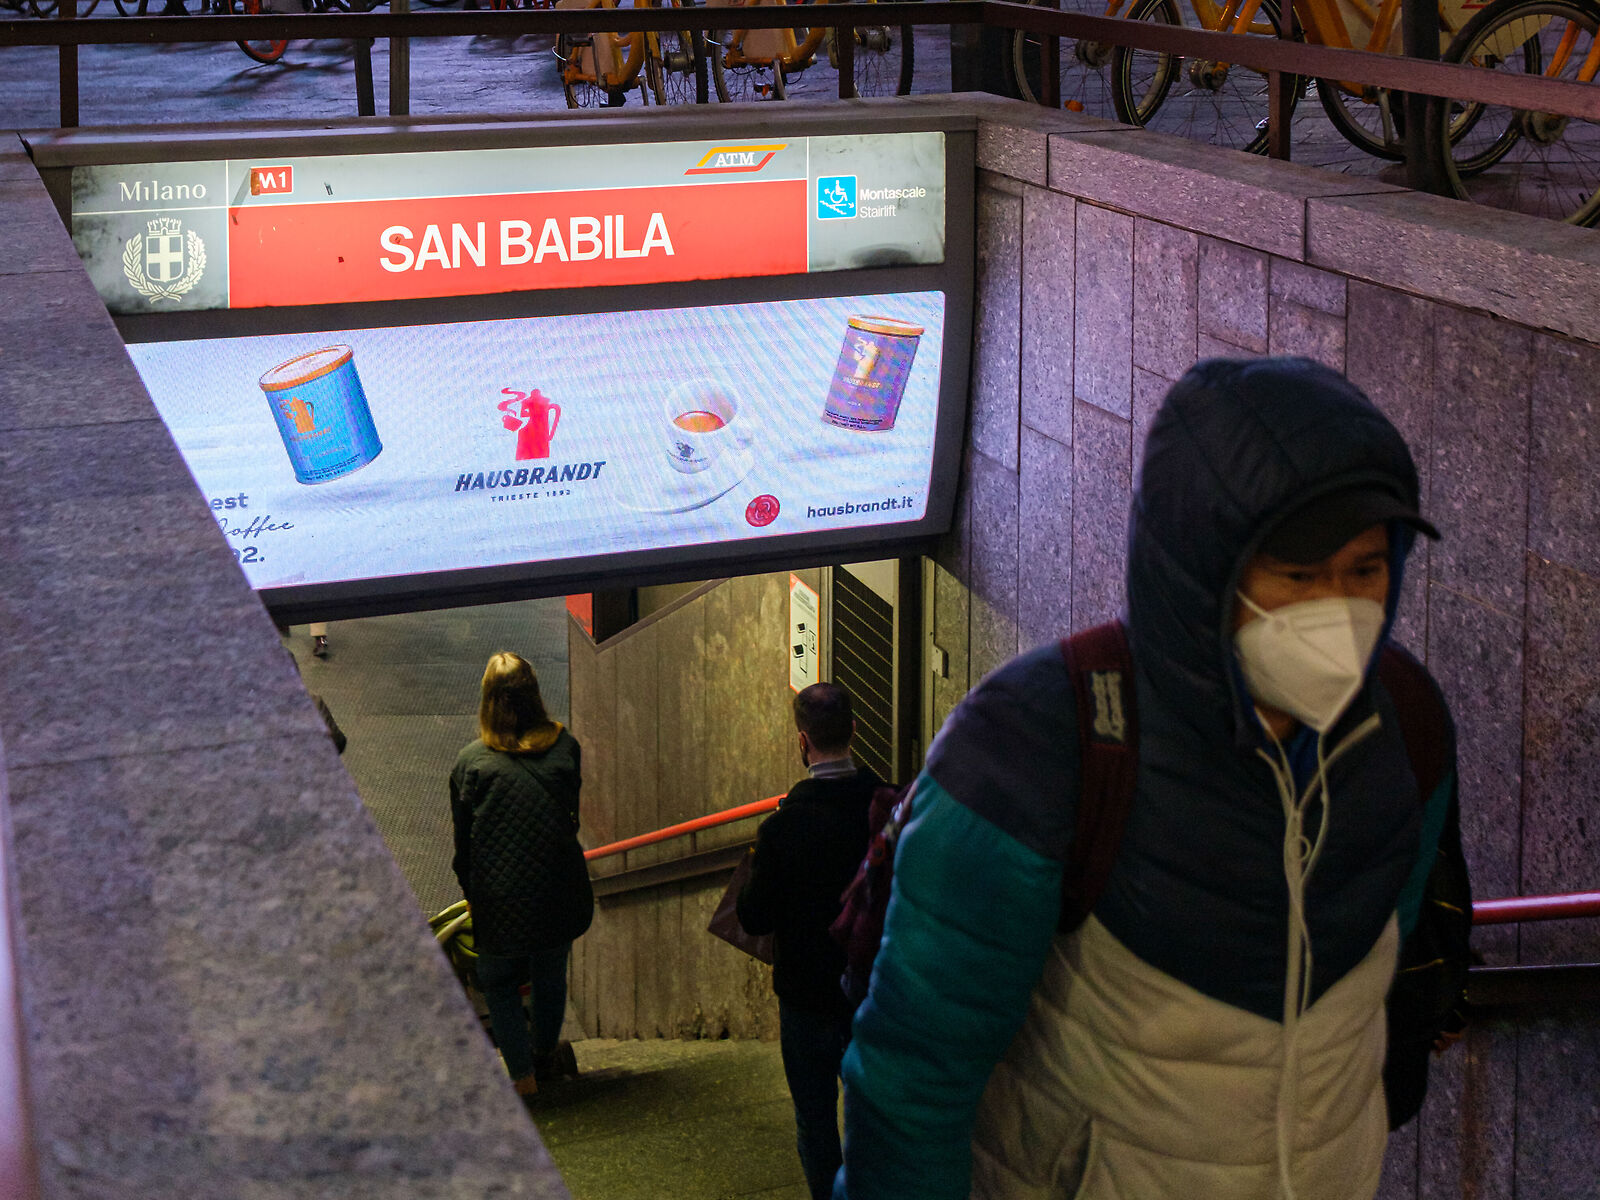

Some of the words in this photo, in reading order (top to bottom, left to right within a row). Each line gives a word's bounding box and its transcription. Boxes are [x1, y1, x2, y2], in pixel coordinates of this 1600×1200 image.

[714, 152, 755, 168] ATM
[118, 180, 207, 202] Milano
[859, 186, 926, 201] Montascale
[859, 204, 897, 219] Stairlift
[379, 221, 486, 273] SAN
[500, 212, 675, 266] BABILA
[454, 461, 607, 492] HAUSBRANDT
[491, 492, 539, 502] TRIESTE
[807, 496, 914, 518] hausbrandt.it
